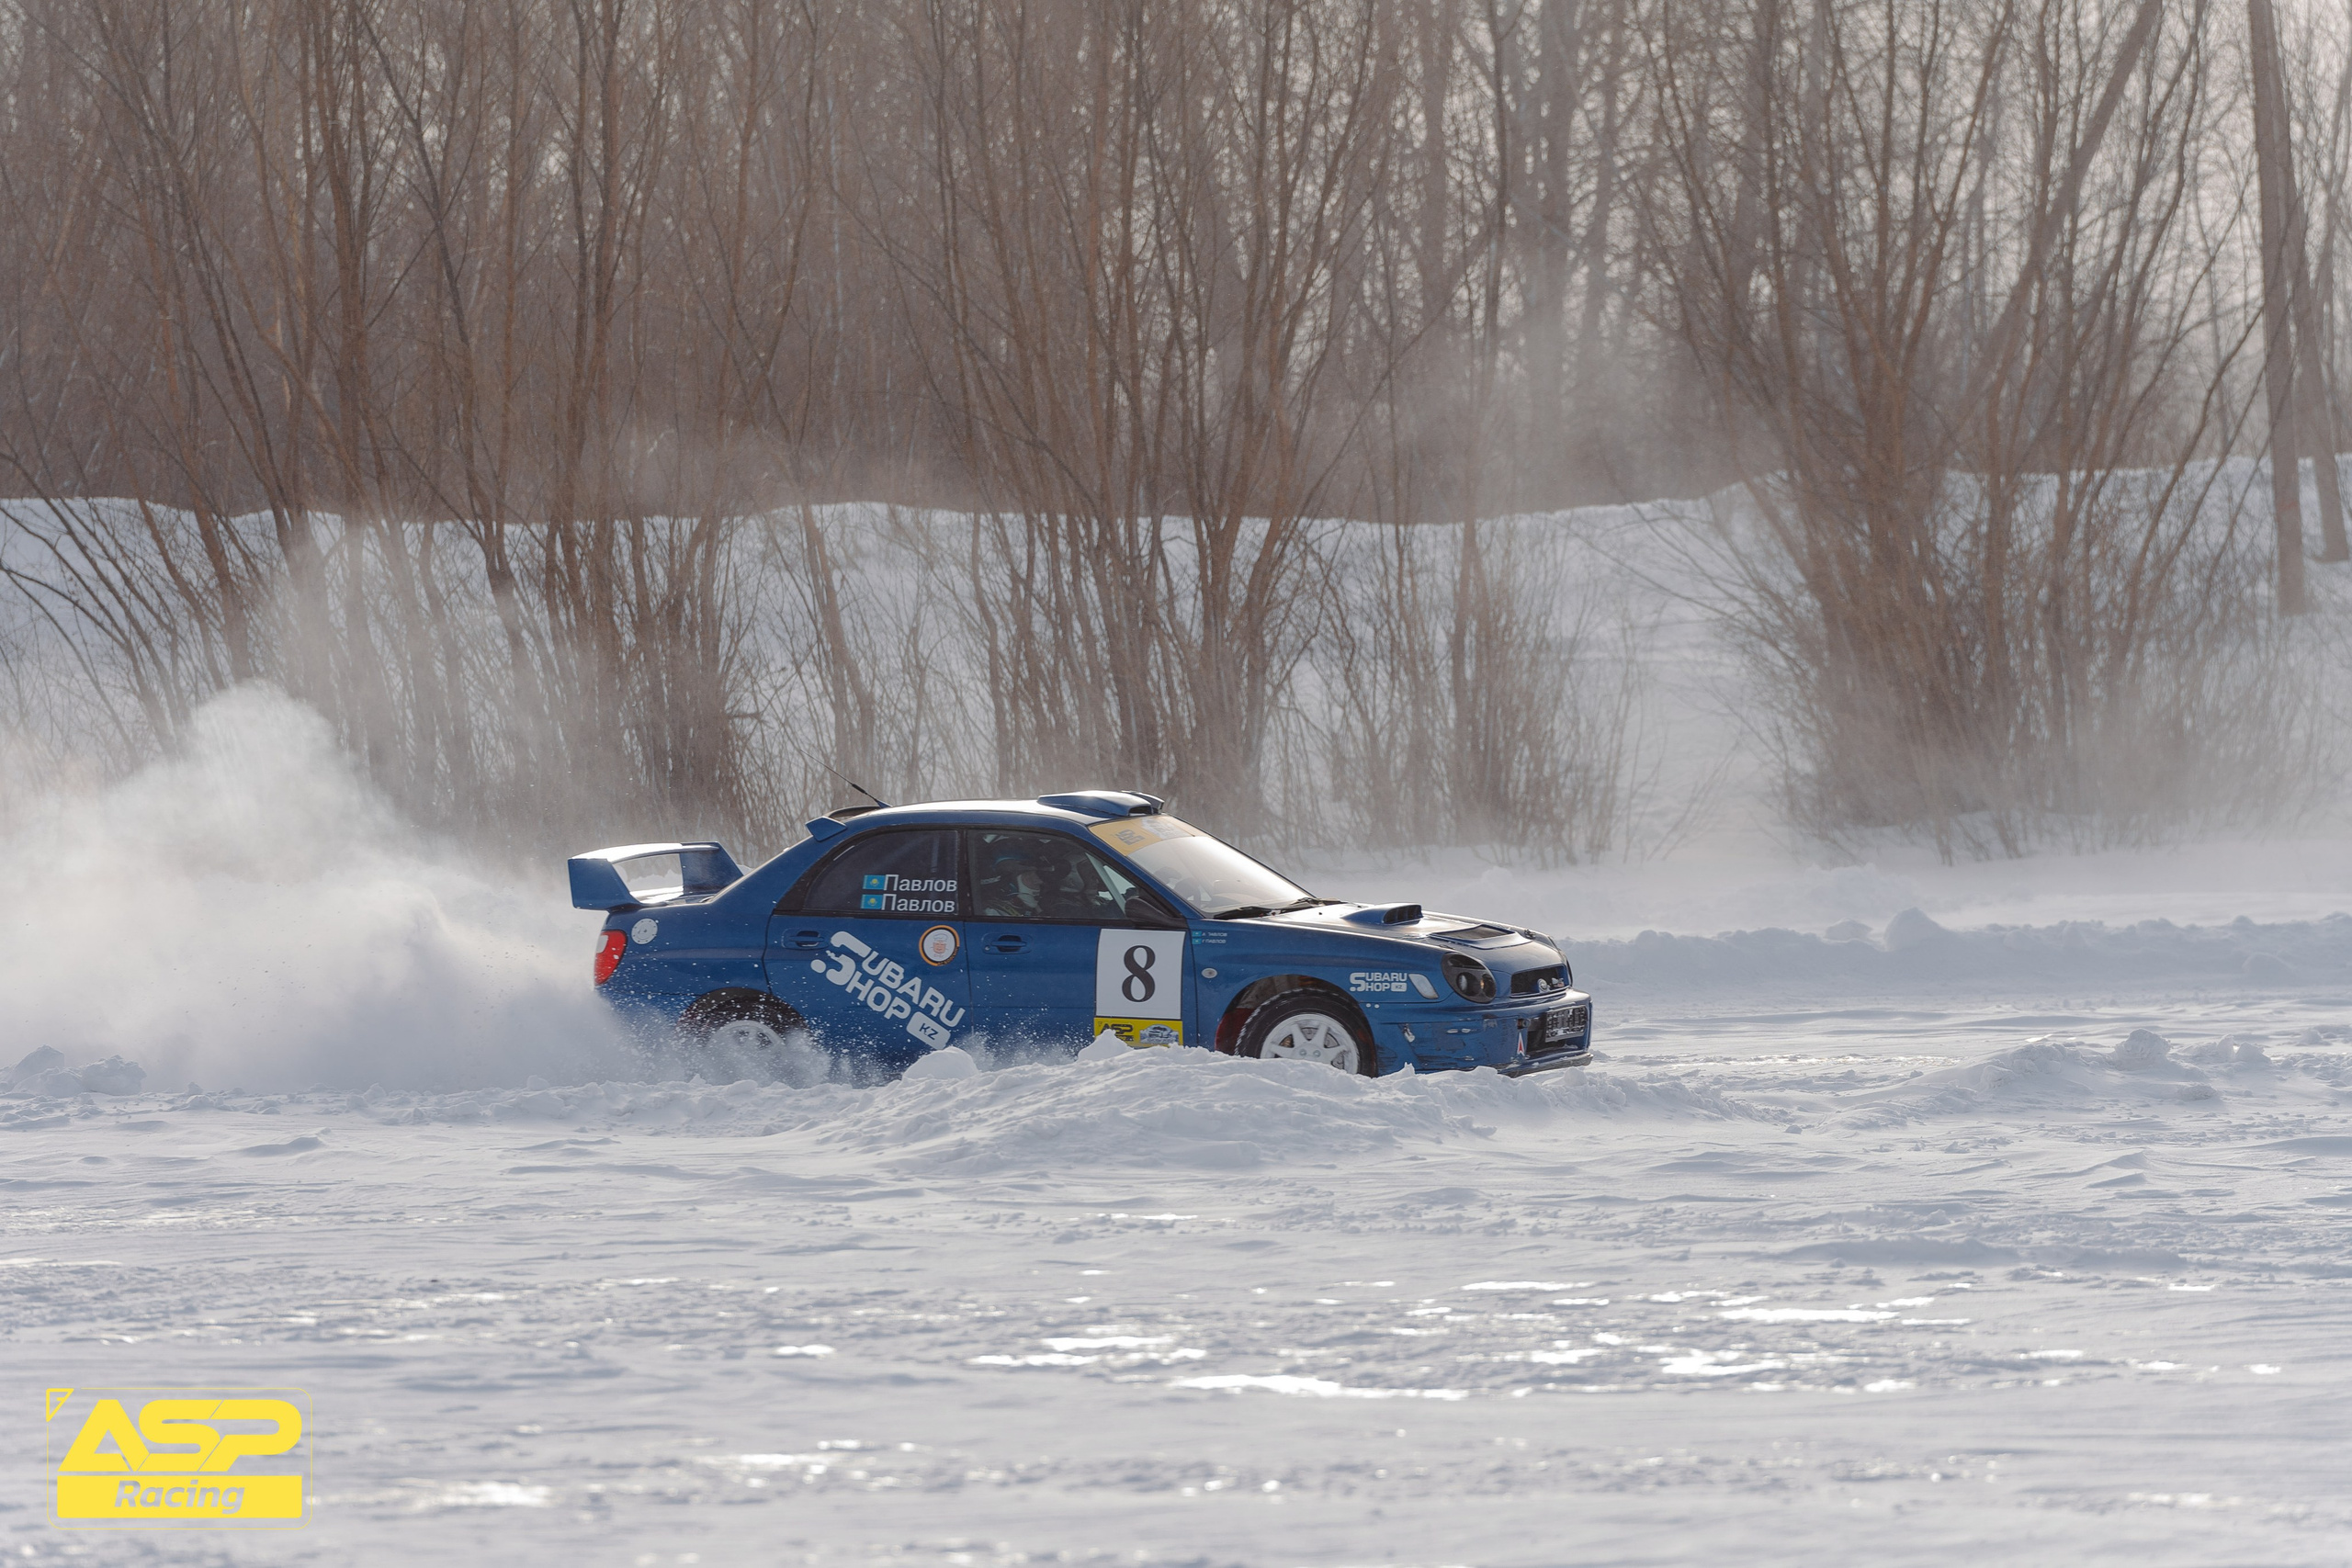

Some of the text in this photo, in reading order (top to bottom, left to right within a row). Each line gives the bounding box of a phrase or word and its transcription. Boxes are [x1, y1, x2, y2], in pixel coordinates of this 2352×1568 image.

[884, 874, 957, 892] Павлов
[881, 893, 956, 912] Павлов
[810, 931, 966, 1028] SUBARU
[1122, 945, 1156, 1002] 8
[1350, 973, 1408, 991] SUBARU
[918, 1022, 940, 1041] KZ
